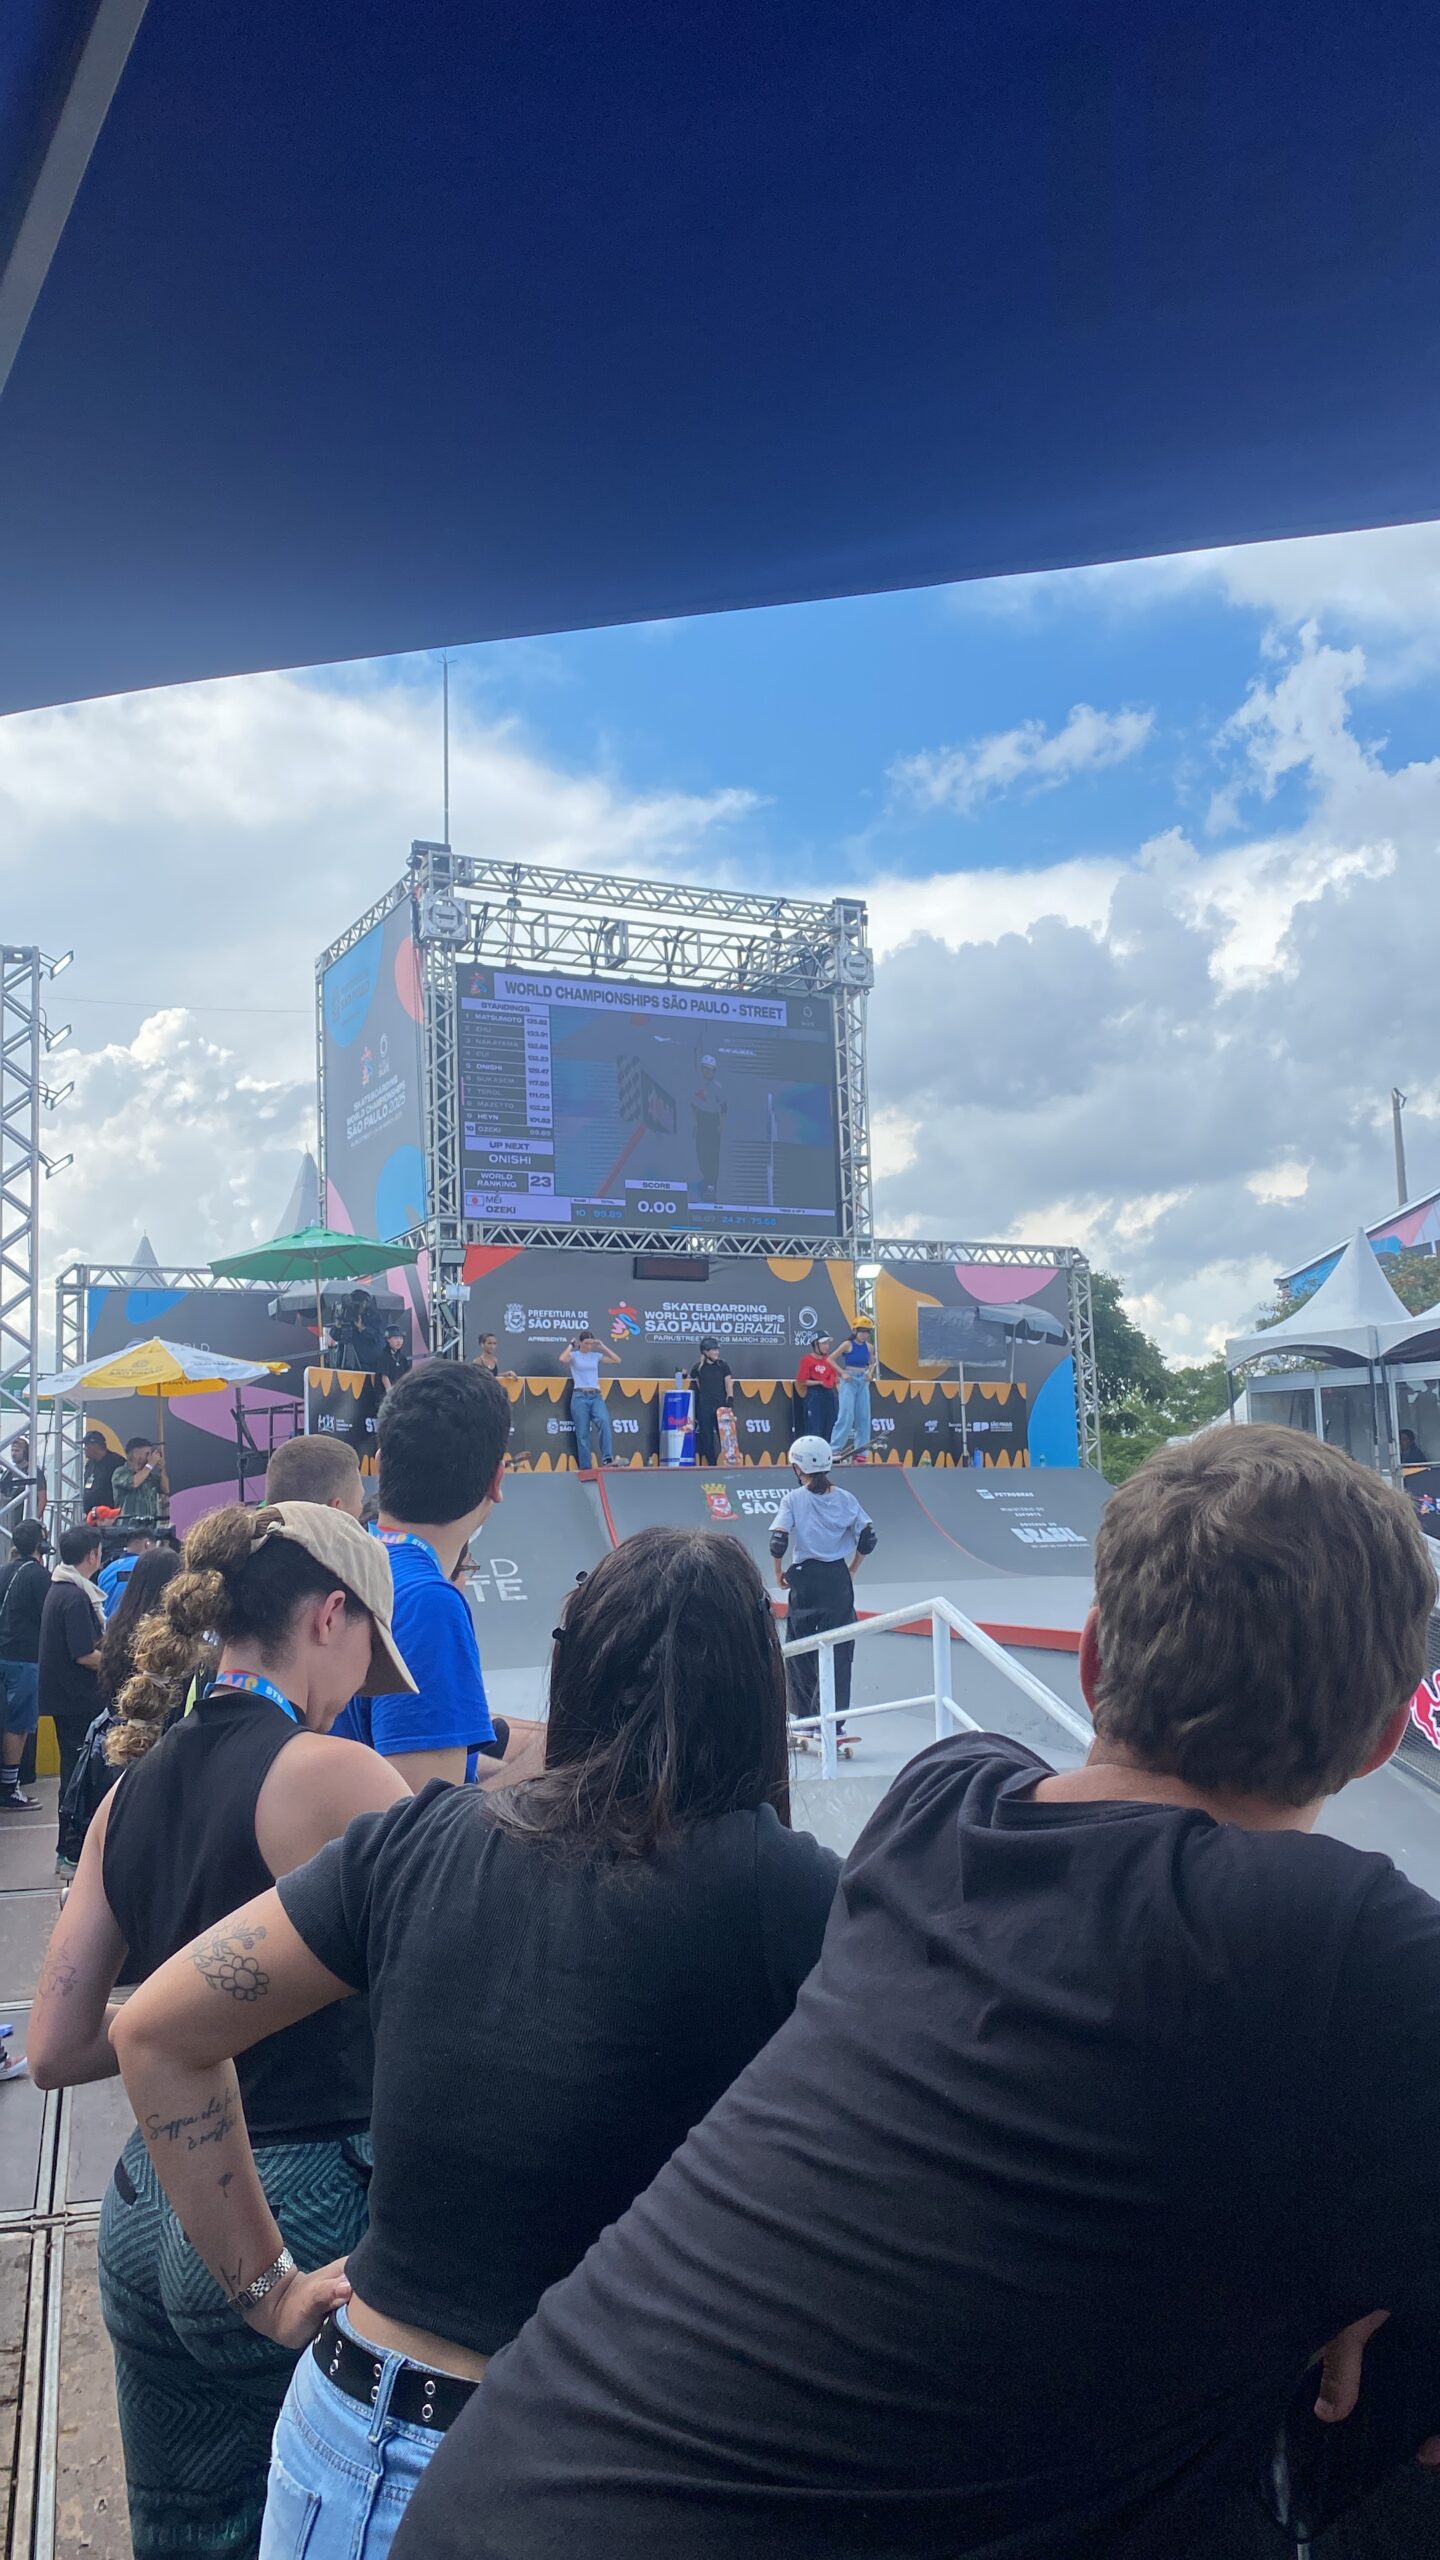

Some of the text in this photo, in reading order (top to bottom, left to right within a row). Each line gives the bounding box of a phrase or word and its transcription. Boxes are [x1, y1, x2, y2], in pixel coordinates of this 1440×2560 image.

[505, 981, 552, 997] WORLD
[555, 987, 659, 1008] CHAMPIONSHIPS
[662, 995, 688, 1011] SÃO
[690, 1000, 730, 1015] PAULO
[739, 1005, 783, 1020] STREET
[481, 1002, 530, 1012] STANDINGS
[475, 1014, 522, 1023] MATSUMOTO
[476, 1063, 503, 1071] ONISHI
[346, 1109, 365, 1126] WORLD
[364, 1104, 388, 1130] PAULO
[477, 1113, 499, 1121] HEYN
[489, 1141, 529, 1151] UP NEXT
[489, 1154, 531, 1165] ONISHI
[481, 1171, 513, 1180] WORLD
[477, 1179, 517, 1188] RANKING
[530, 1176, 551, 1188] 23
[642, 1182, 671, 1190] SCORE
[486, 1196, 501, 1204] MEI
[486, 1206, 516, 1214] OZEKI
[576, 1209, 586, 1217] 10
[638, 1201, 676, 1214] 0.00
[662, 1302, 768, 1313] SKATEBOARDING
[528, 1309, 576, 1318] PREFEITURA
[644, 1311, 785, 1322] WORLD CHAMPIONSHIPS
[528, 1317, 589, 1330] SÃO PAULO
[645, 1319, 785, 1334] SÃO PAULO BRAZIL
[612, 1419, 639, 1433] STU
[745, 1419, 771, 1433] STU
[872, 1418, 896, 1432] STU
[736, 1489, 792, 1500] PREFEITU
[1010, 1527, 1088, 1543] BRASIL
[265, 1685, 284, 1704] STU
